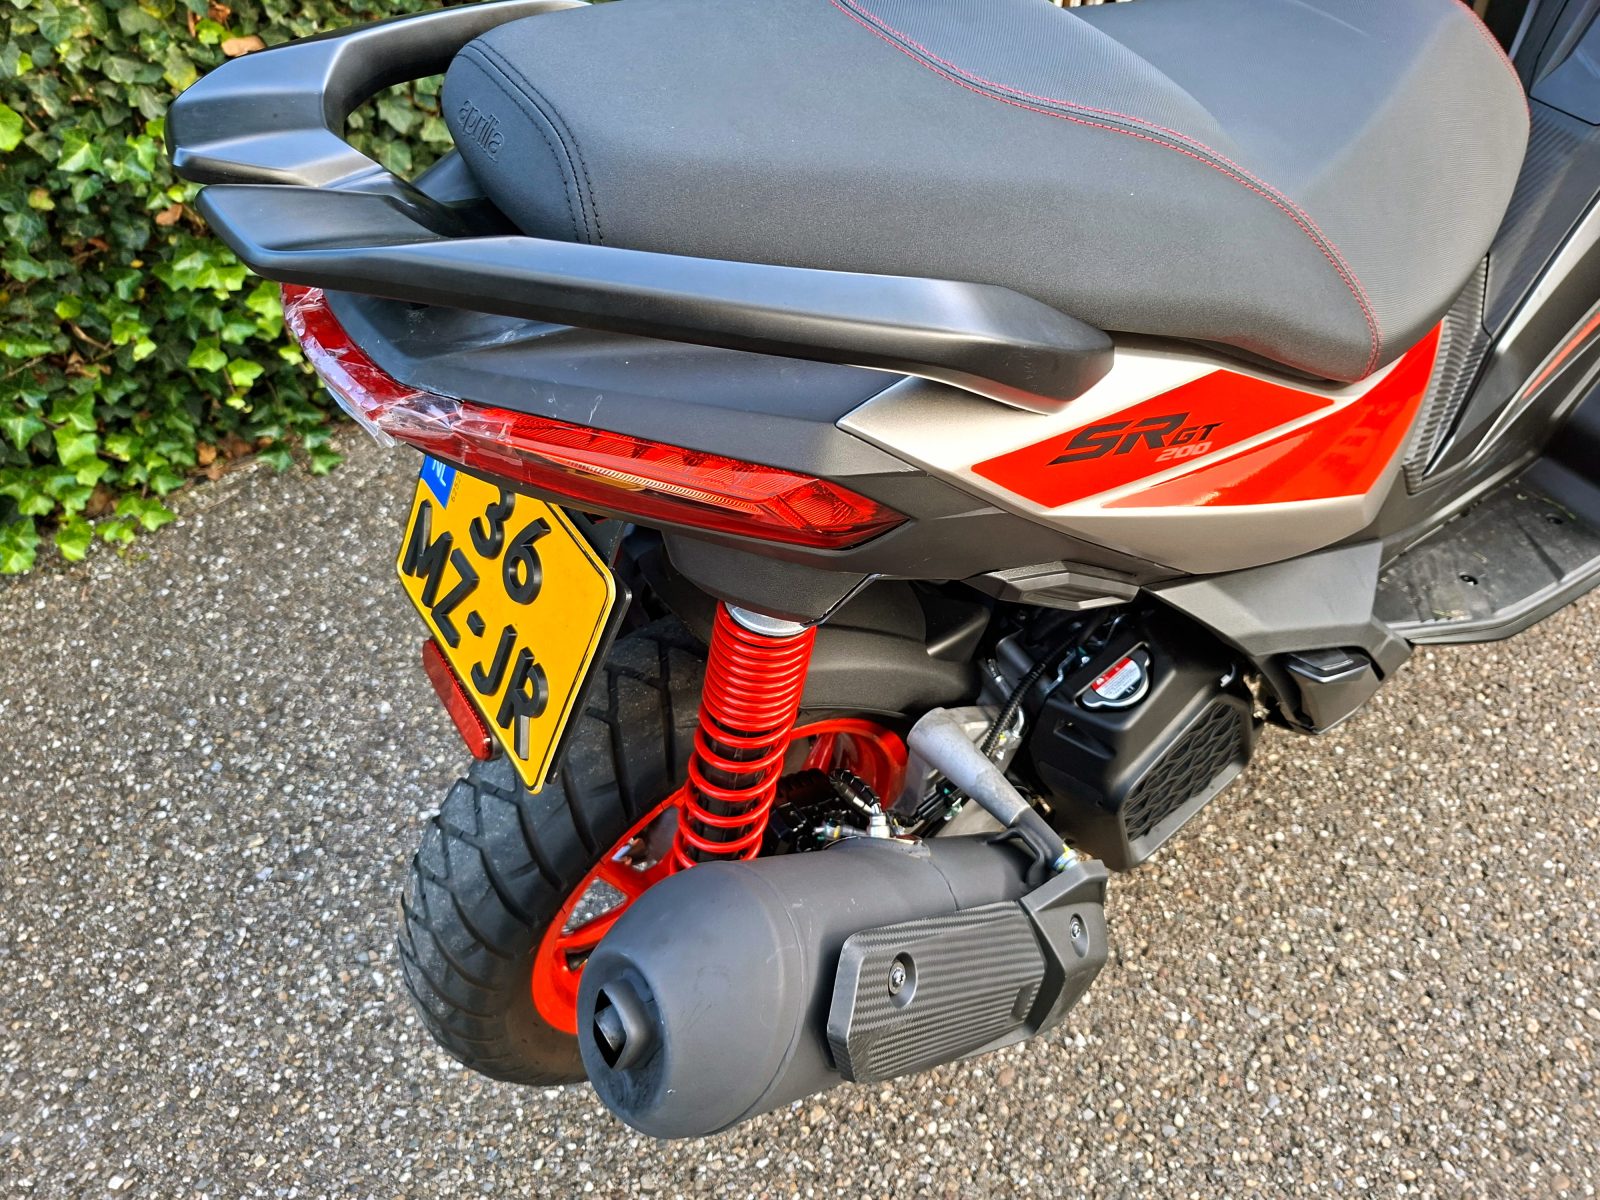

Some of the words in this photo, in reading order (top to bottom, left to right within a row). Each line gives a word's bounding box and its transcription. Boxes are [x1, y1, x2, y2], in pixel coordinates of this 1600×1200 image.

[457, 99, 505, 162] aprilia
[1047, 413, 1189, 465] SR
[1169, 423, 1223, 446] GT
[1154, 441, 1213, 463] 200
[431, 459, 447, 487] NL
[470, 491, 551, 604] 36
